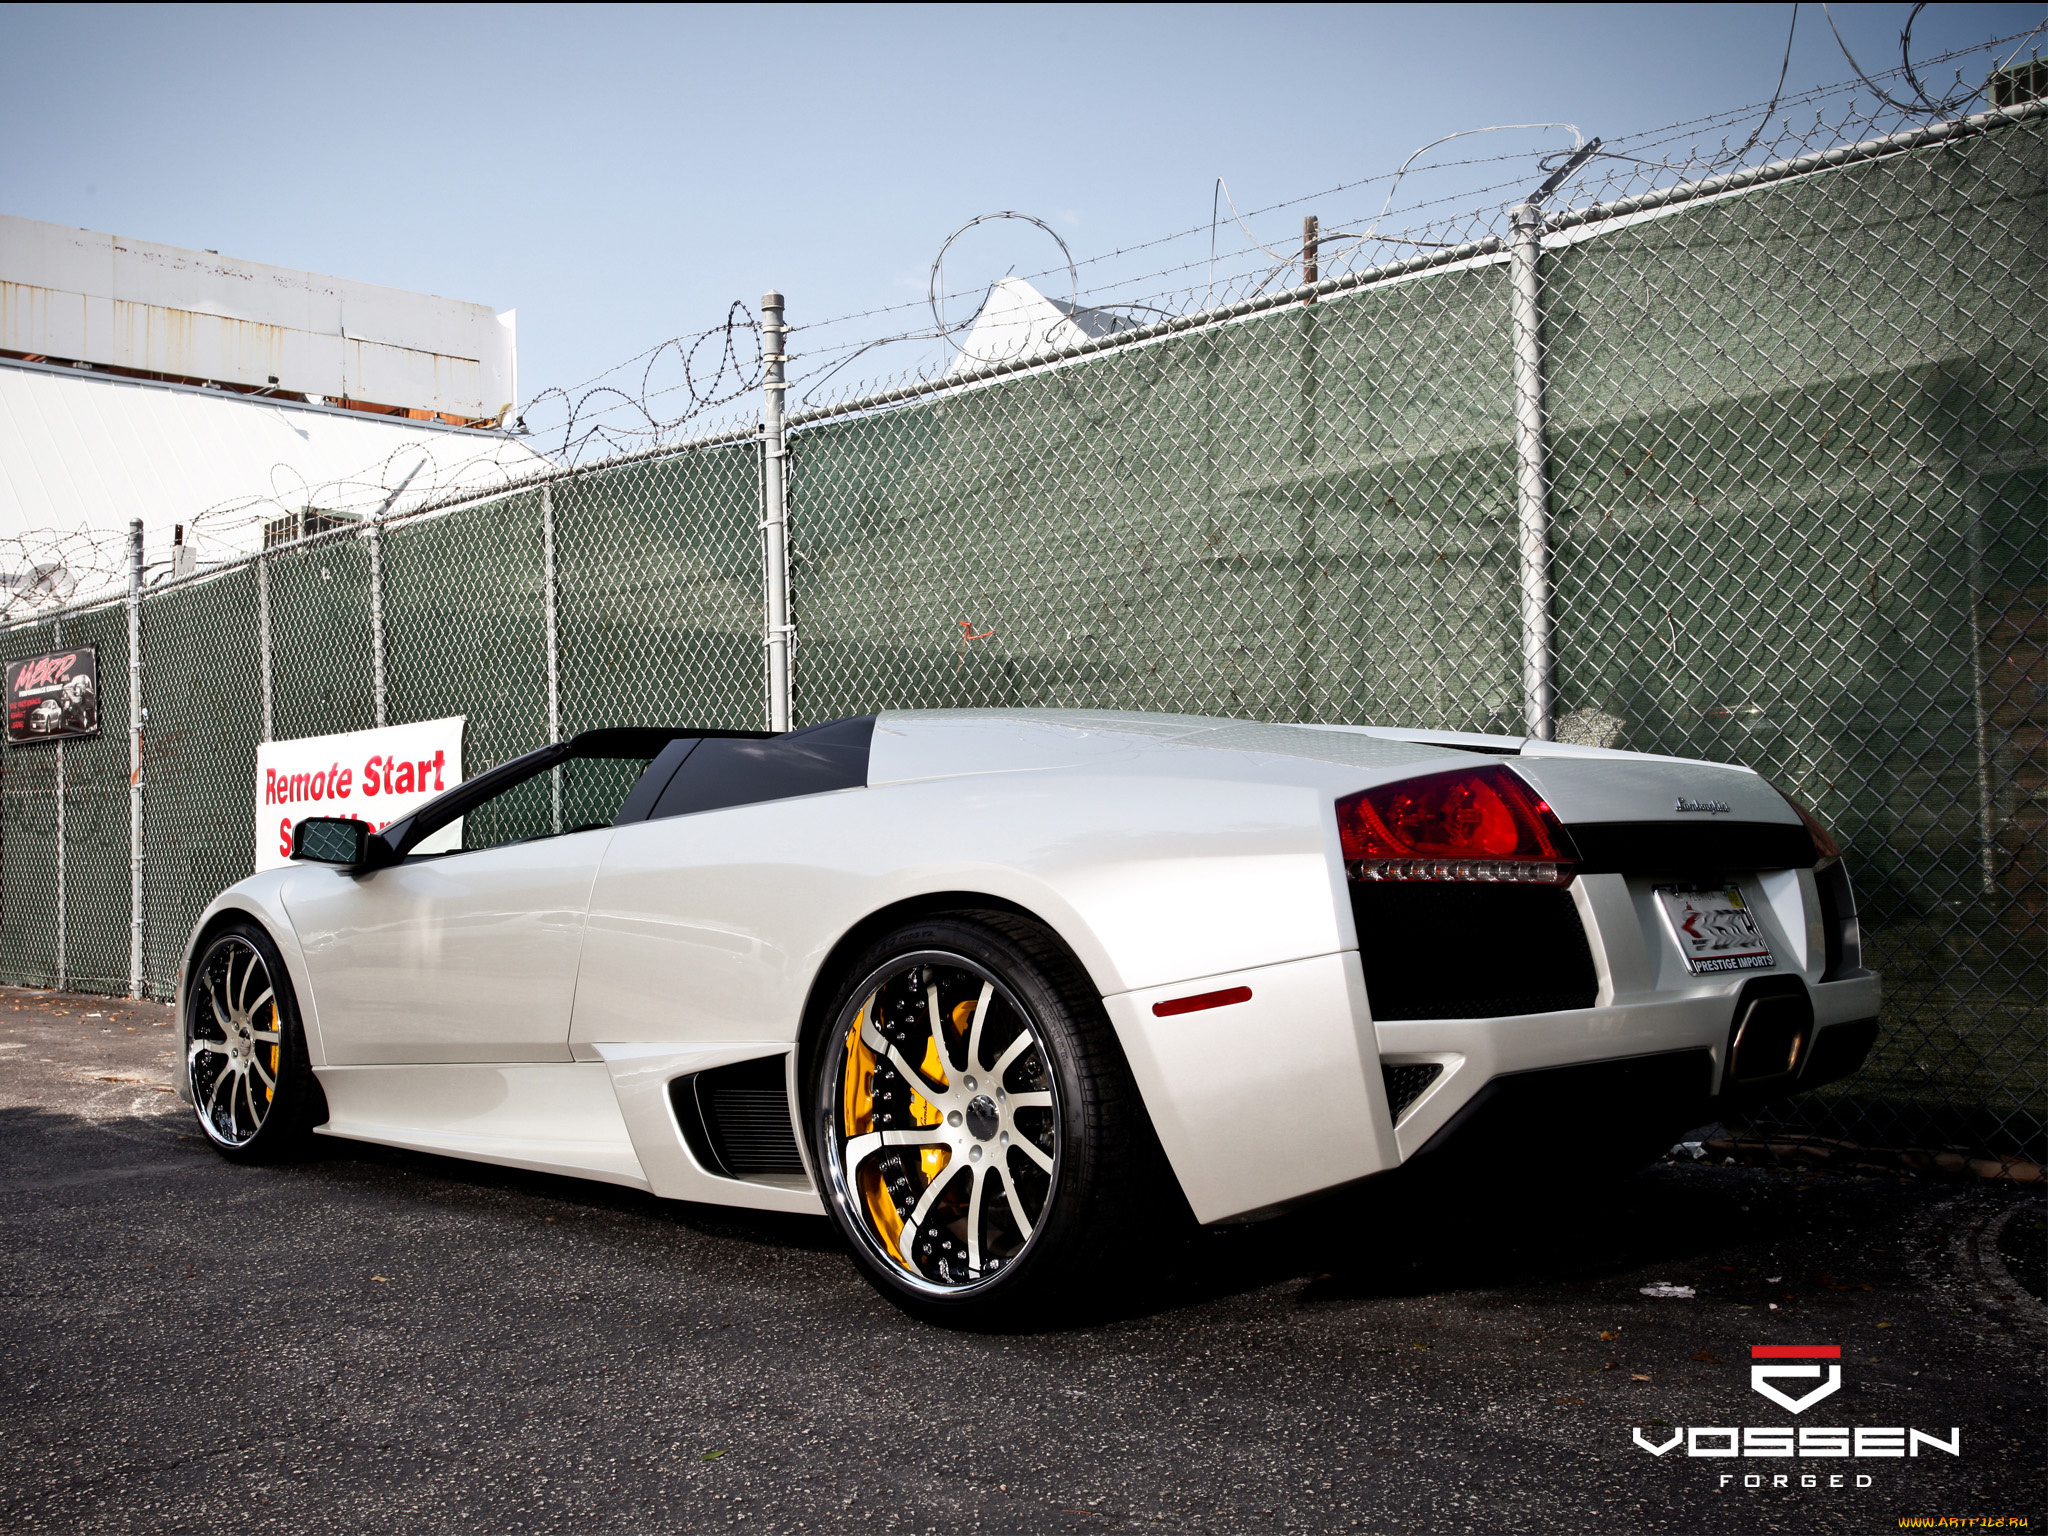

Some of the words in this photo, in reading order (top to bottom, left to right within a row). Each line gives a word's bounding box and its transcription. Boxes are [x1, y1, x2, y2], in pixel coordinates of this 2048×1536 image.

[14, 654, 76, 692] MBRP
[266, 762, 352, 805] Remote
[362, 750, 445, 796] Start
[1676, 797, 1730, 814] Lamborghini
[1696, 959, 1738, 972] PRESTIGE
[1738, 956, 1774, 968] IMPORTS
